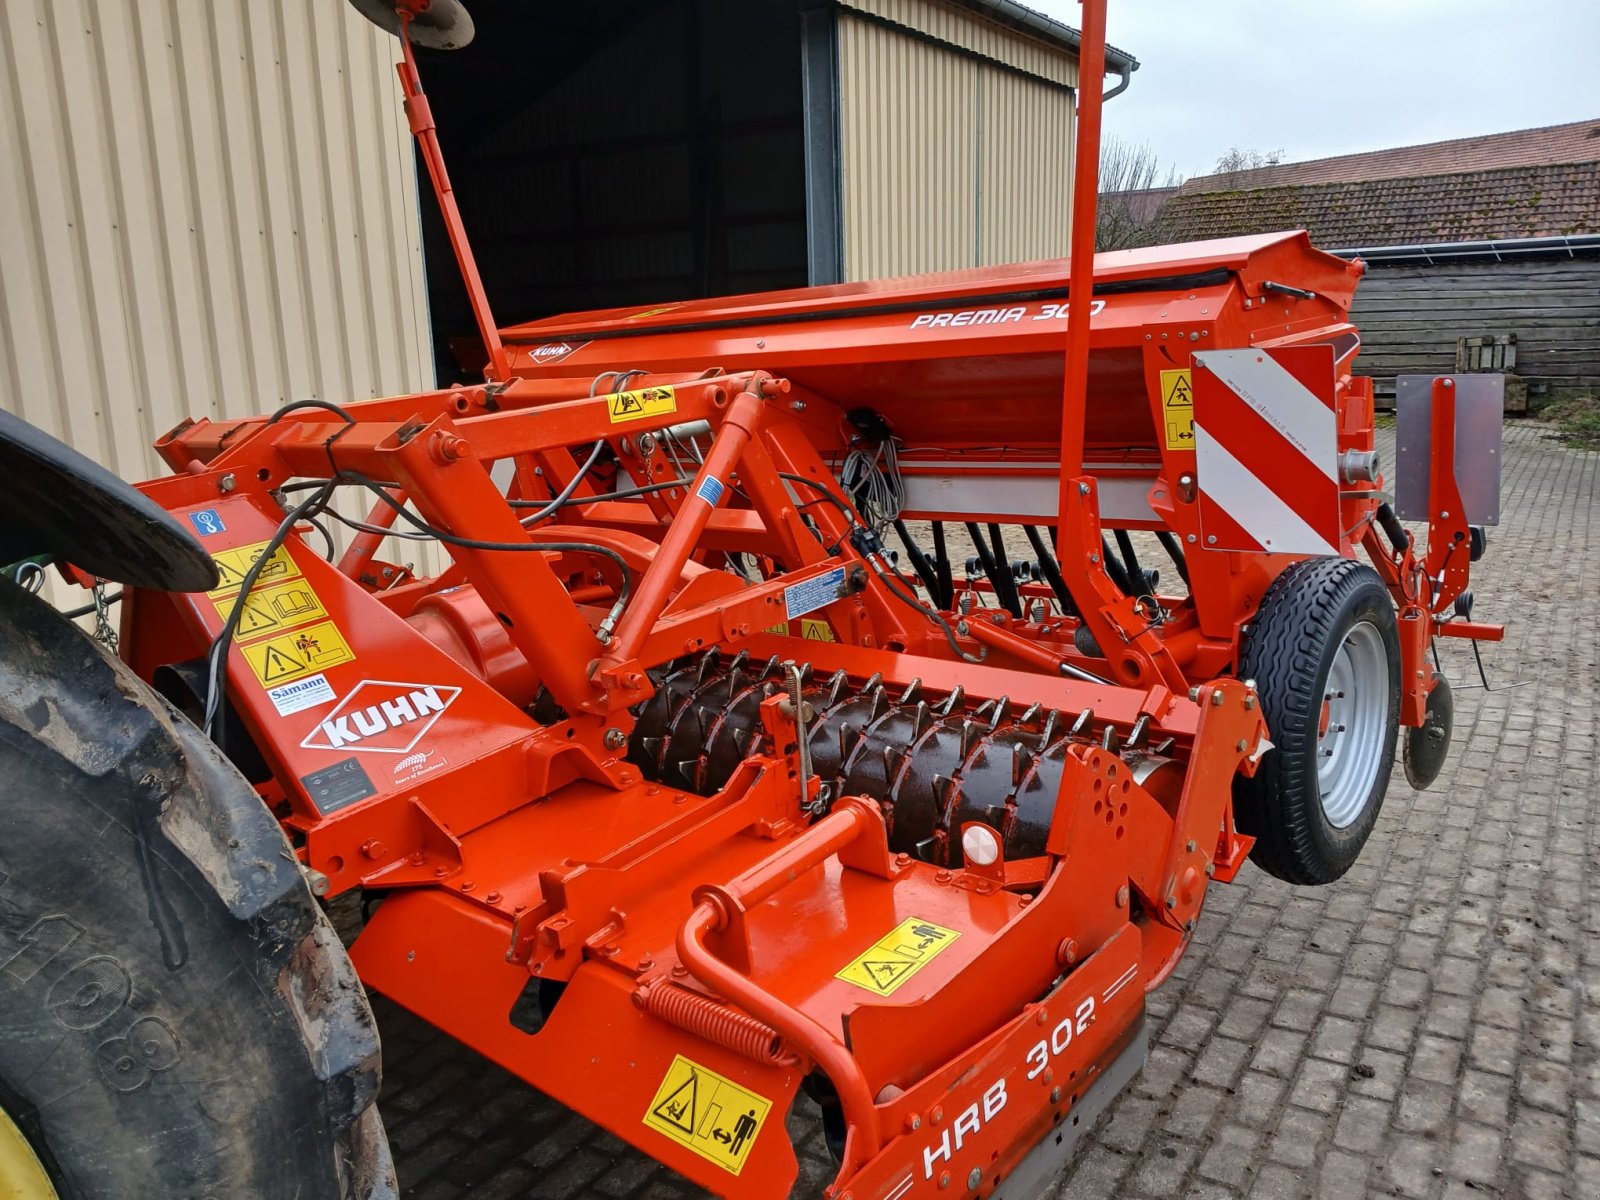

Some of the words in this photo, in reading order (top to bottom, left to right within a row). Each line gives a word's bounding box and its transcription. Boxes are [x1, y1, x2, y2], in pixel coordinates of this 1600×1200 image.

[909, 306, 1027, 330] PREMIA
[532, 346, 568, 357] KUHN
[271, 677, 325, 699] Sämann
[321, 685, 445, 748] KUHN
[417, 762, 444, 776] Excellence
[923, 1077, 1008, 1180] HRB
[1026, 995, 1096, 1080] 302
